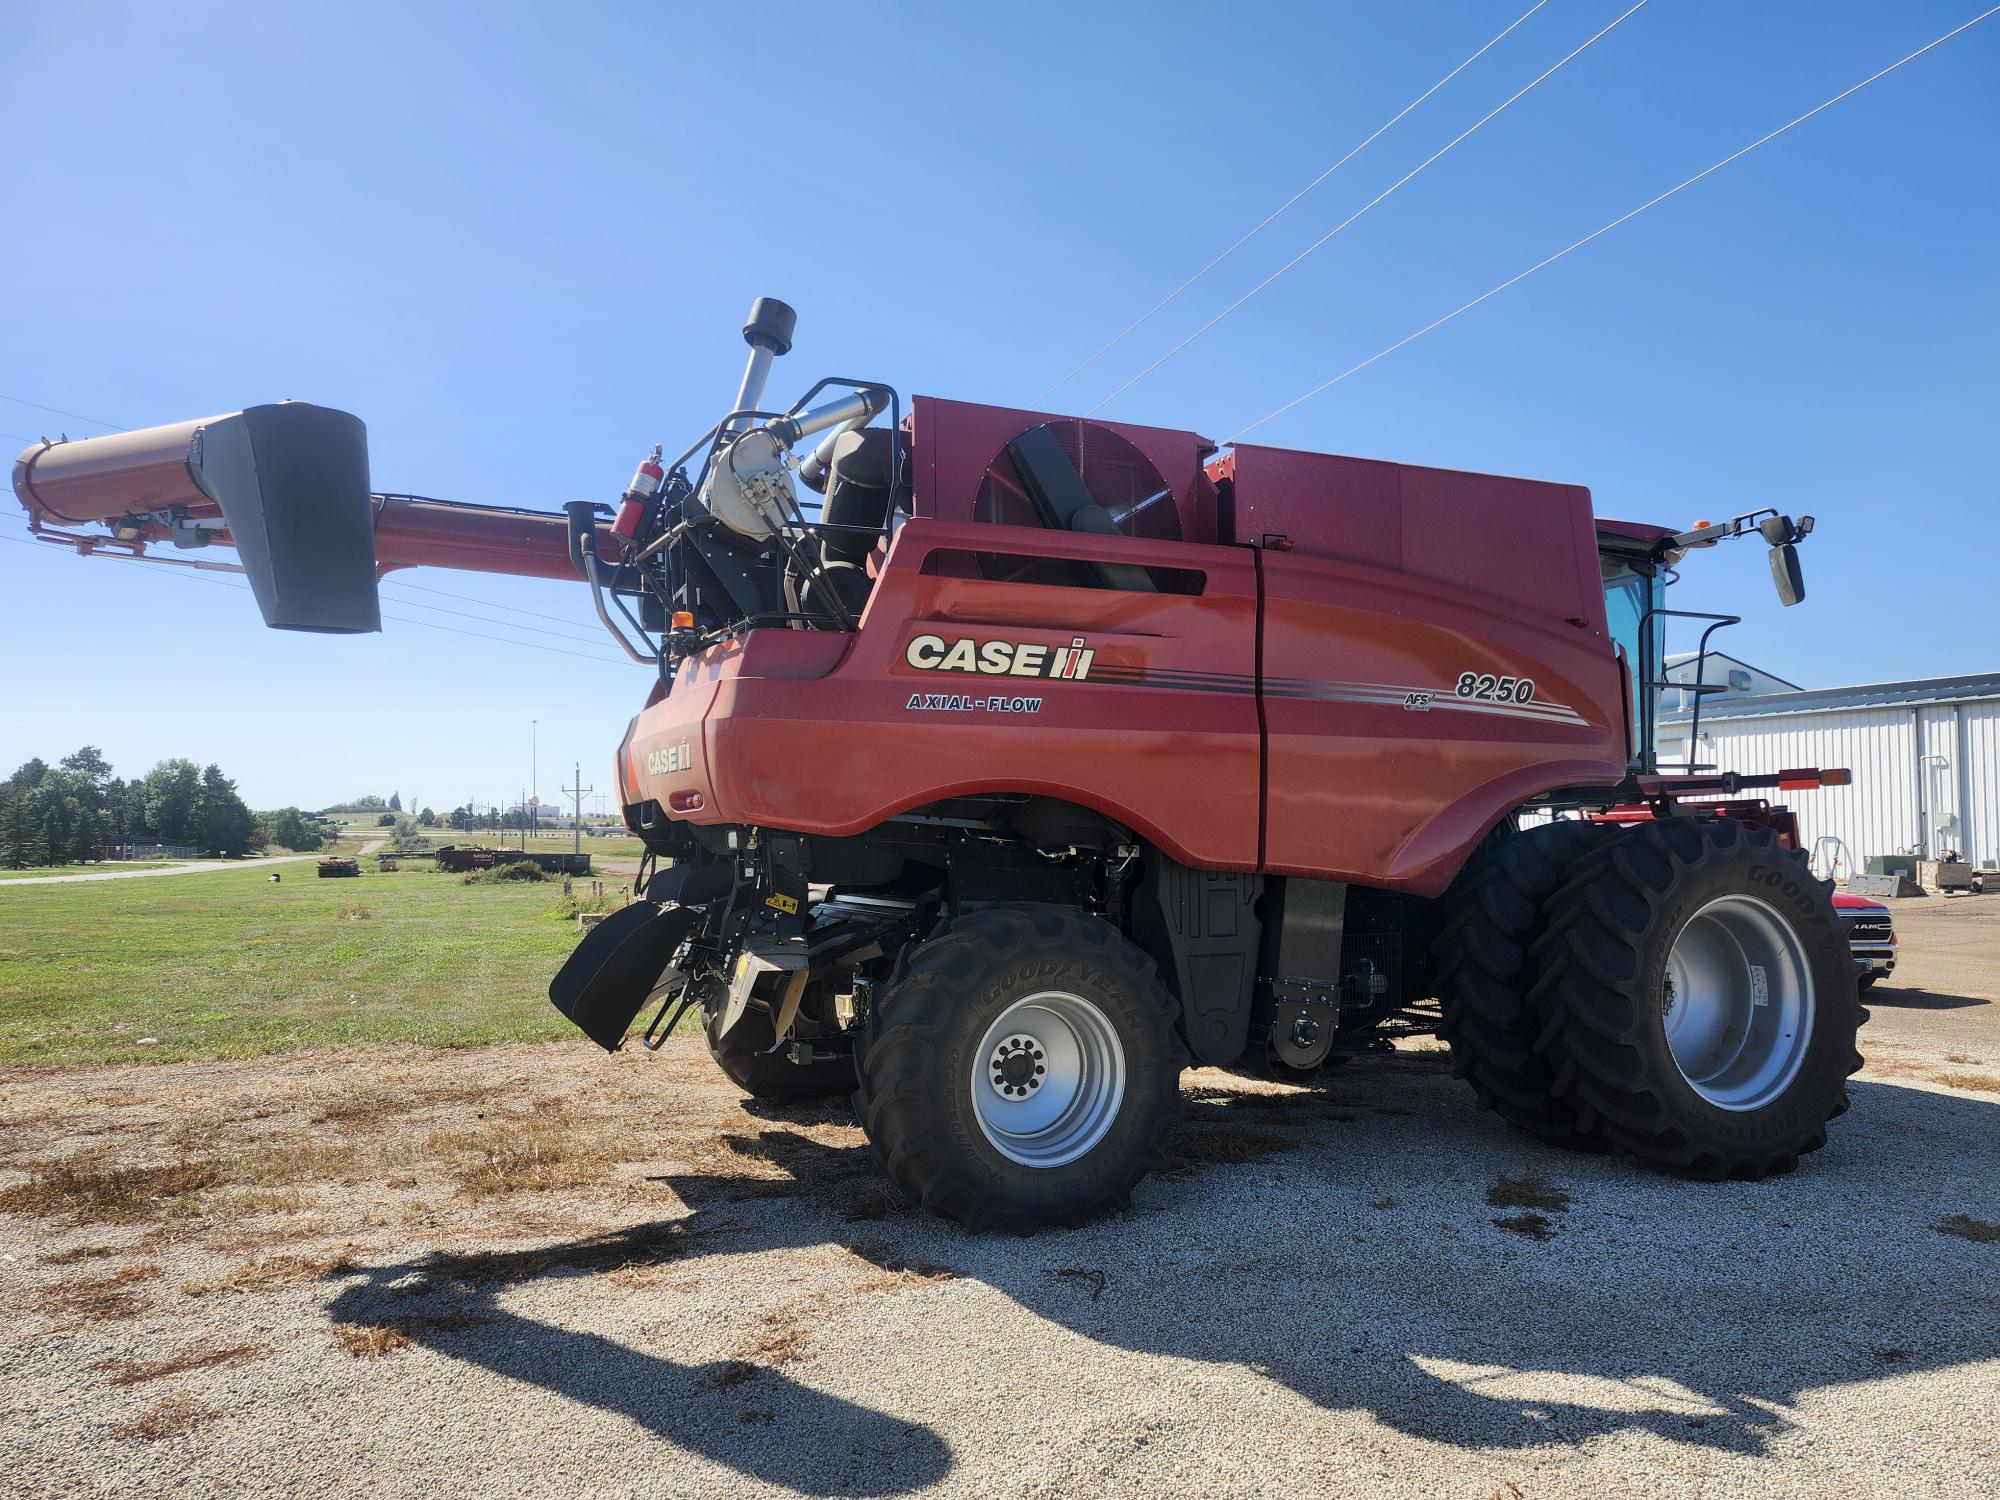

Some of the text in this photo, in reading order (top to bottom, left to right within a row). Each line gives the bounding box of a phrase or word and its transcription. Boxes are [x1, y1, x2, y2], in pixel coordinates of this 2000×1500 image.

[906, 634, 1048, 677] CASE
[906, 694, 1042, 713] AXIAL-FLOW
[1404, 692, 1429, 705] AFS
[1456, 671, 1535, 706] 8250
[648, 746, 677, 776] CASE
